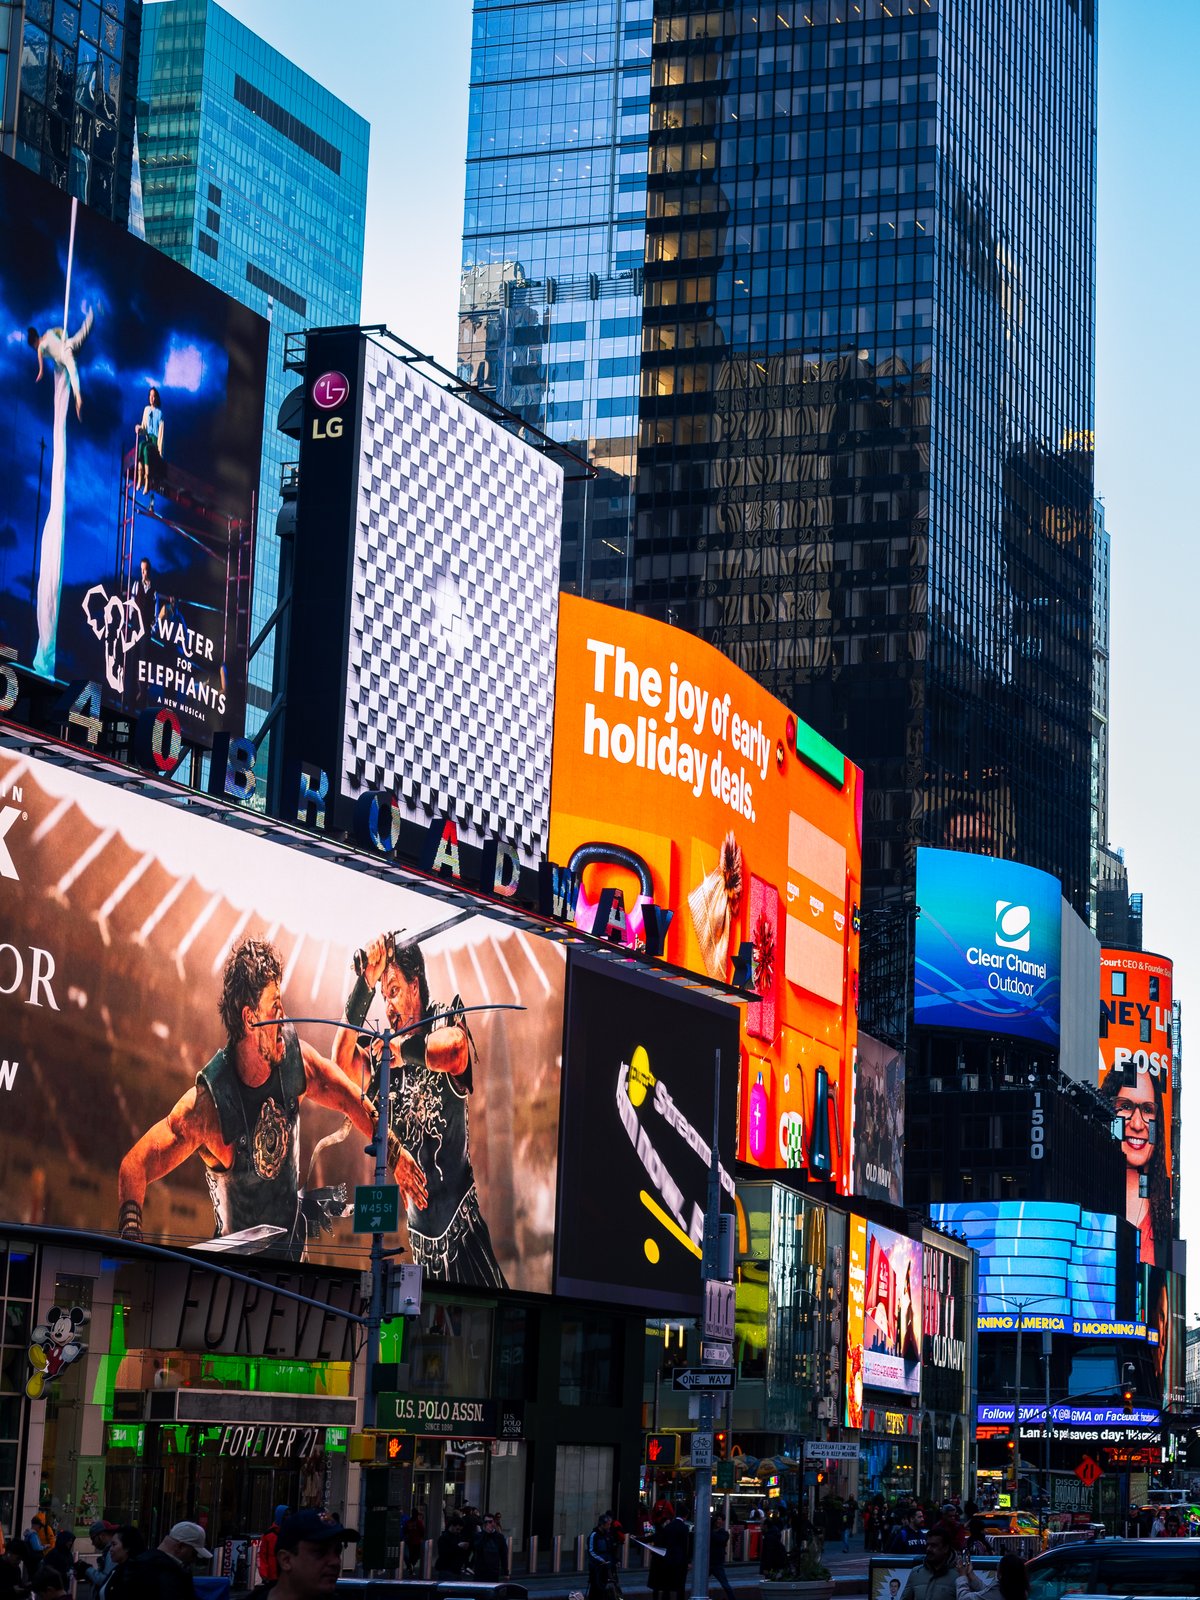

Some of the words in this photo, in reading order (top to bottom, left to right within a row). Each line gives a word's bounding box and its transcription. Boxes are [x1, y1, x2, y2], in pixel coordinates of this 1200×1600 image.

[312, 417, 343, 439] LG
[157, 617, 214, 661] WATER
[176, 657, 192, 673] FOR
[138, 660, 226, 715] ELEPHANTS
[163, 698, 178, 710] NEW
[179, 702, 206, 722] MUSICAL
[587, 638, 662, 707] The
[664, 662, 709, 735] joy
[711, 693, 731, 741] of
[731, 712, 770, 781] early
[584, 703, 707, 798] holiday
[710, 750, 756, 824] deals.
[224, 737, 675, 956] BROADWAY
[966, 947, 1004, 969] Clear
[1006, 953, 1047, 980] Channel
[1122, 960, 1137, 969] CEO
[1138, 961, 1144, 970] &
[988, 972, 1034, 997] Outdoor
[1031, 1092, 1044, 1159] 1500
[866, 1162, 877, 1182] OLD
[372, 1190, 383, 1200] TO
[360, 1204, 368, 1213] W
[369, 1204, 381, 1213] 45
[383, 1203, 392, 1213] St
[1014, 1319, 1064, 1330] AMERICA
[1082, 1323, 1134, 1335] MORNING
[933, 1334, 947, 1368] OLD
[947, 1337, 965, 1372] NAVY
[682, 1375, 700, 1384] ONE
[709, 1375, 727, 1384] WAY
[395, 1399, 415, 1419] U.S.
[418, 1400, 450, 1420] POLO
[451, 1402, 484, 1422] ASSN.
[982, 1408, 1013, 1419] Follow
[1052, 1409, 1058, 1419] X
[1071, 1411, 1092, 1421] GMA
[1094, 1413, 1104, 1421] on
[425, 1422, 441, 1431] SINCE
[976, 1426, 1010, 1439] SPN
[1070, 1430, 1099, 1440] saves
[1101, 1429, 1124, 1442] day:
[220, 1426, 296, 1457] FOREVER
[299, 1426, 319, 1458] 21
